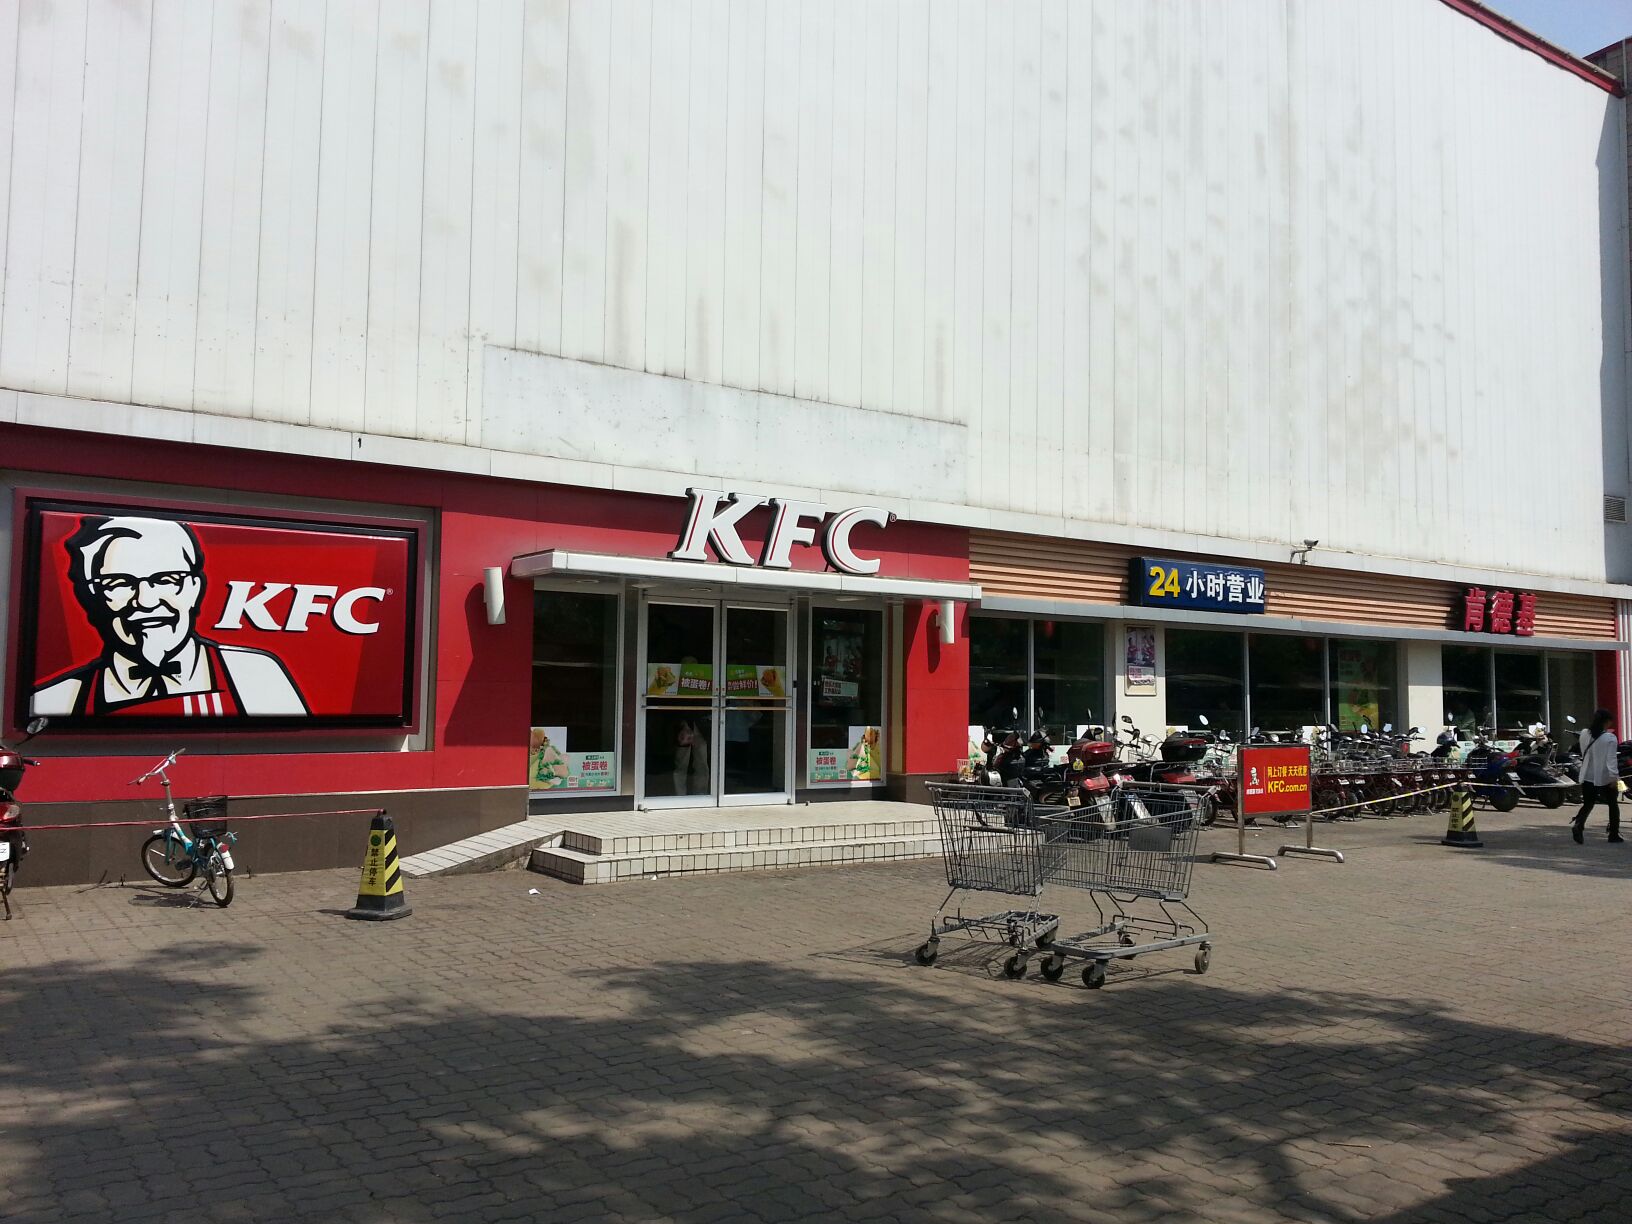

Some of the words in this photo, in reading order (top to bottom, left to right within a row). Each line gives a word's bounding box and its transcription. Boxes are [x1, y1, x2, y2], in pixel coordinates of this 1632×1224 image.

[667, 487, 890, 575] KFC
[214, 580, 386, 635] KFC
[1185, 569, 1265, 604] 小时营业
[1464, 586, 1538, 637] 肯德基
[1268, 780, 1308, 793] KFC.com.cn
[367, 847, 380, 887] 禁止停车
